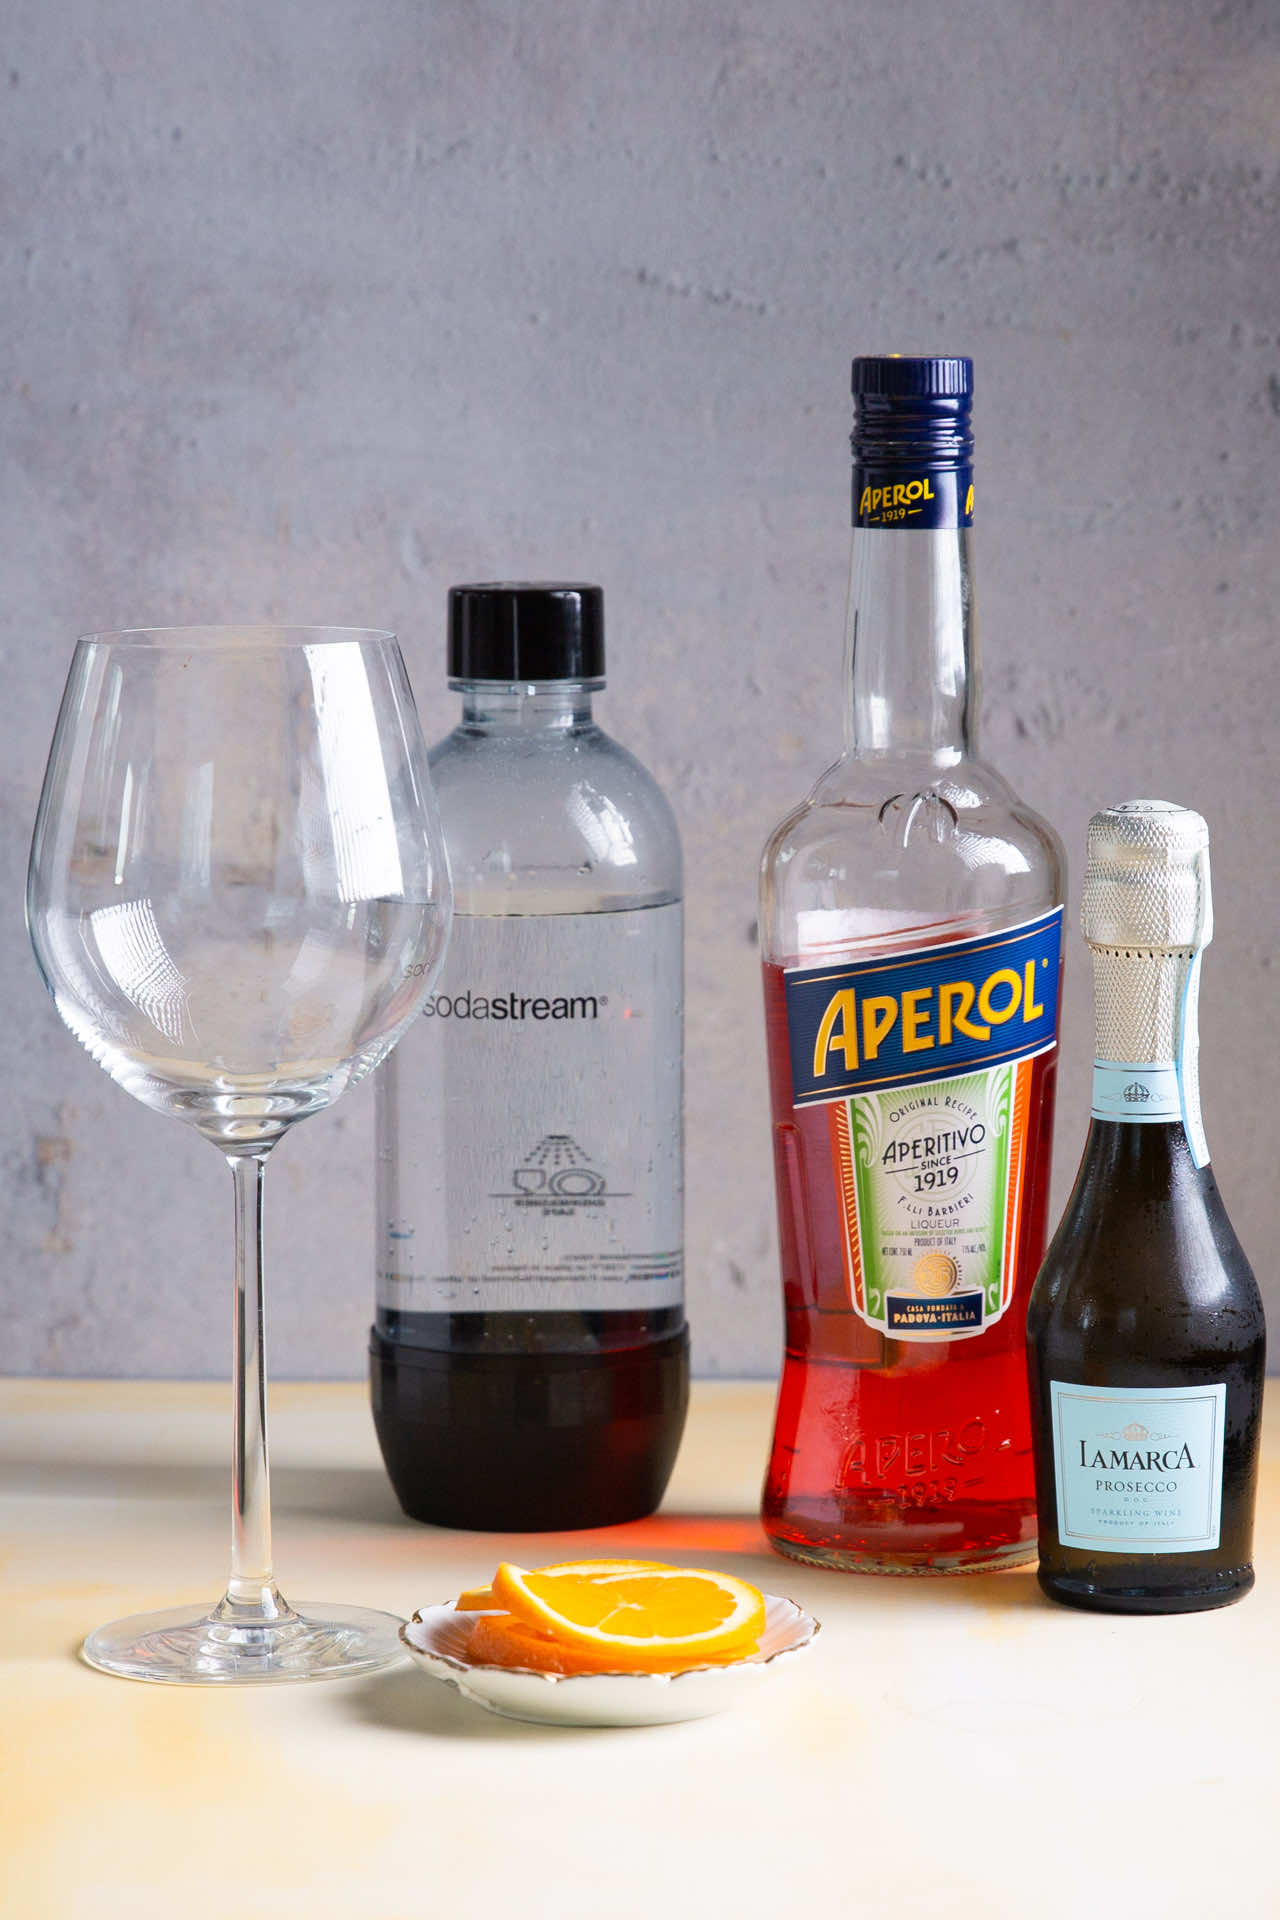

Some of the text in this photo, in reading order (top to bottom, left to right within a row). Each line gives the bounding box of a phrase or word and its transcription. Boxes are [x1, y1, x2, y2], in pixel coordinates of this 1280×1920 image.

[859, 478, 935, 516] APEROL
[881, 508, 906, 523] 1919
[813, 960, 1044, 1078] APEROL
[889, 1095, 978, 1122] ORIGINAL RECIPE
[882, 1124, 986, 1165] APERITIVO
[920, 1156, 952, 1171] SINCE
[914, 1166, 959, 1193] 1919
[928, 1193, 974, 1217] BARBIERI
[911, 1218, 960, 1229] LIQUEUR
[914, 1238, 935, 1247] PRODUCT
[944, 1236, 957, 1246] ITALY
[906, 1304, 924, 1313] CASA
[1096, 1480, 1177, 1492] PROSECCO
[1091, 1507, 1182, 1518] SPARKLING WINE
